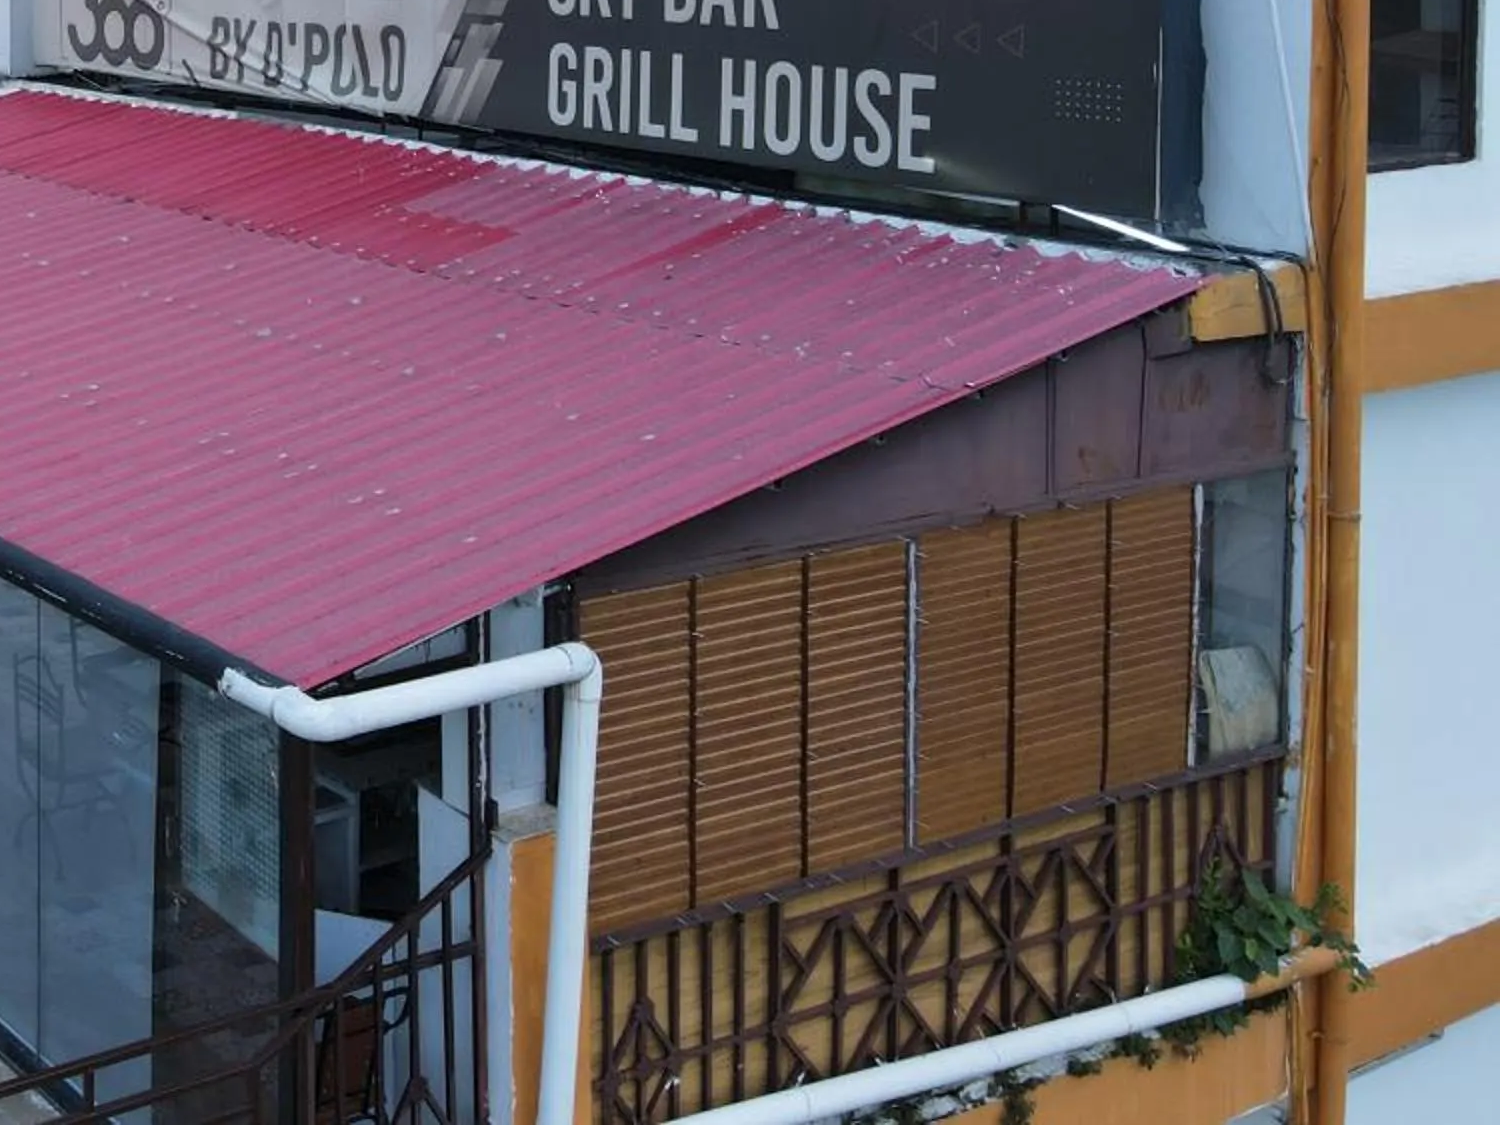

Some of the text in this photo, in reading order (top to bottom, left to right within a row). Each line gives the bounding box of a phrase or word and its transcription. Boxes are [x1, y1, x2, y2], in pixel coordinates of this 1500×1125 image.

[208, 17, 257, 83] BY
[548, 43, 936, 173] GRILL HOUSE
